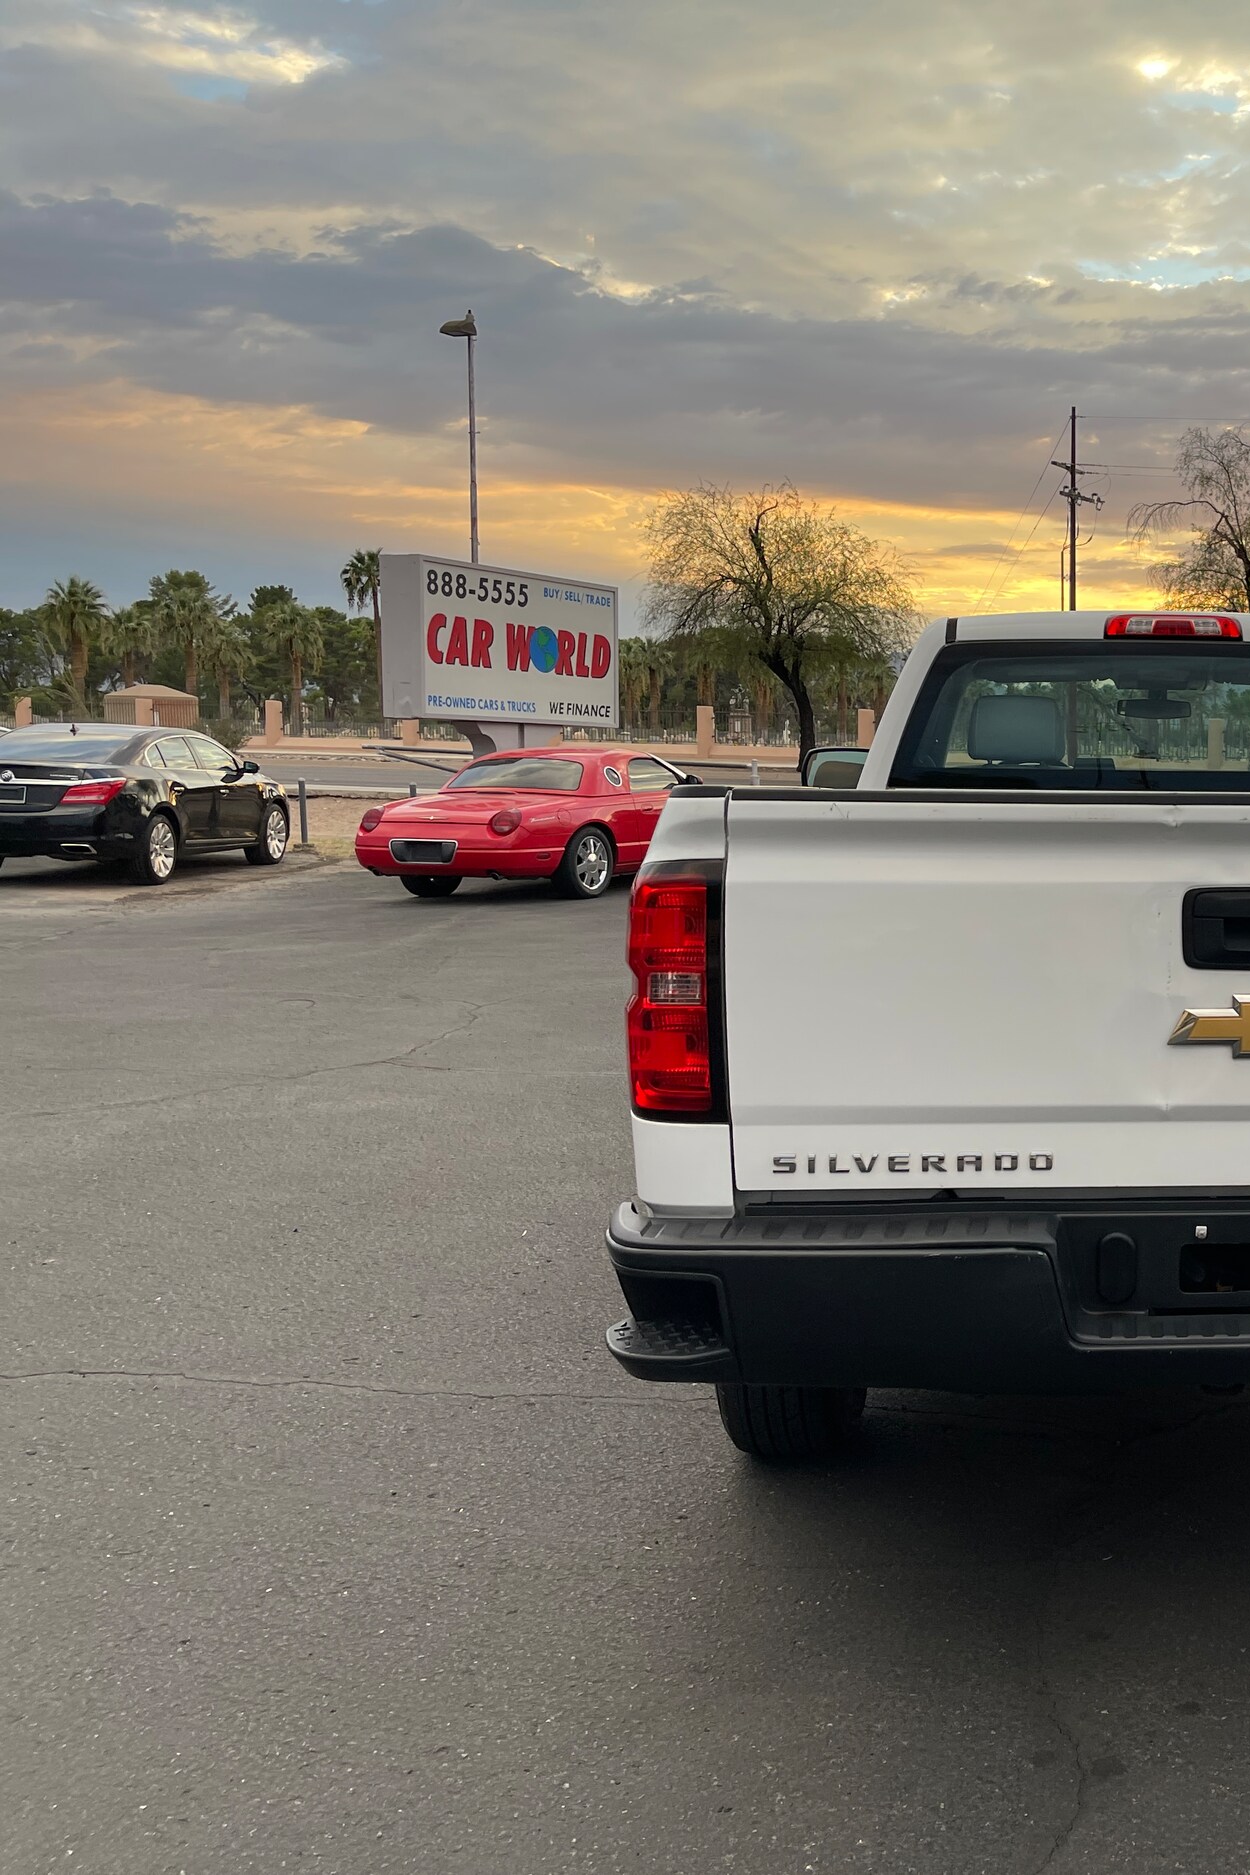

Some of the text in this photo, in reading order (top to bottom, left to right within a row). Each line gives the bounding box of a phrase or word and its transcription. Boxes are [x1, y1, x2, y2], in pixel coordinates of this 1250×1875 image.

[426, 569, 529, 608] 888-5555
[585, 593, 611, 608] TRADE
[426, 613, 494, 669] CAR
[427, 695, 537, 713] PRE-OWNED CARS & TRUCKS
[549, 701, 611, 718] WE FINANCE
[772, 1150, 1053, 1174] SILVERADO
